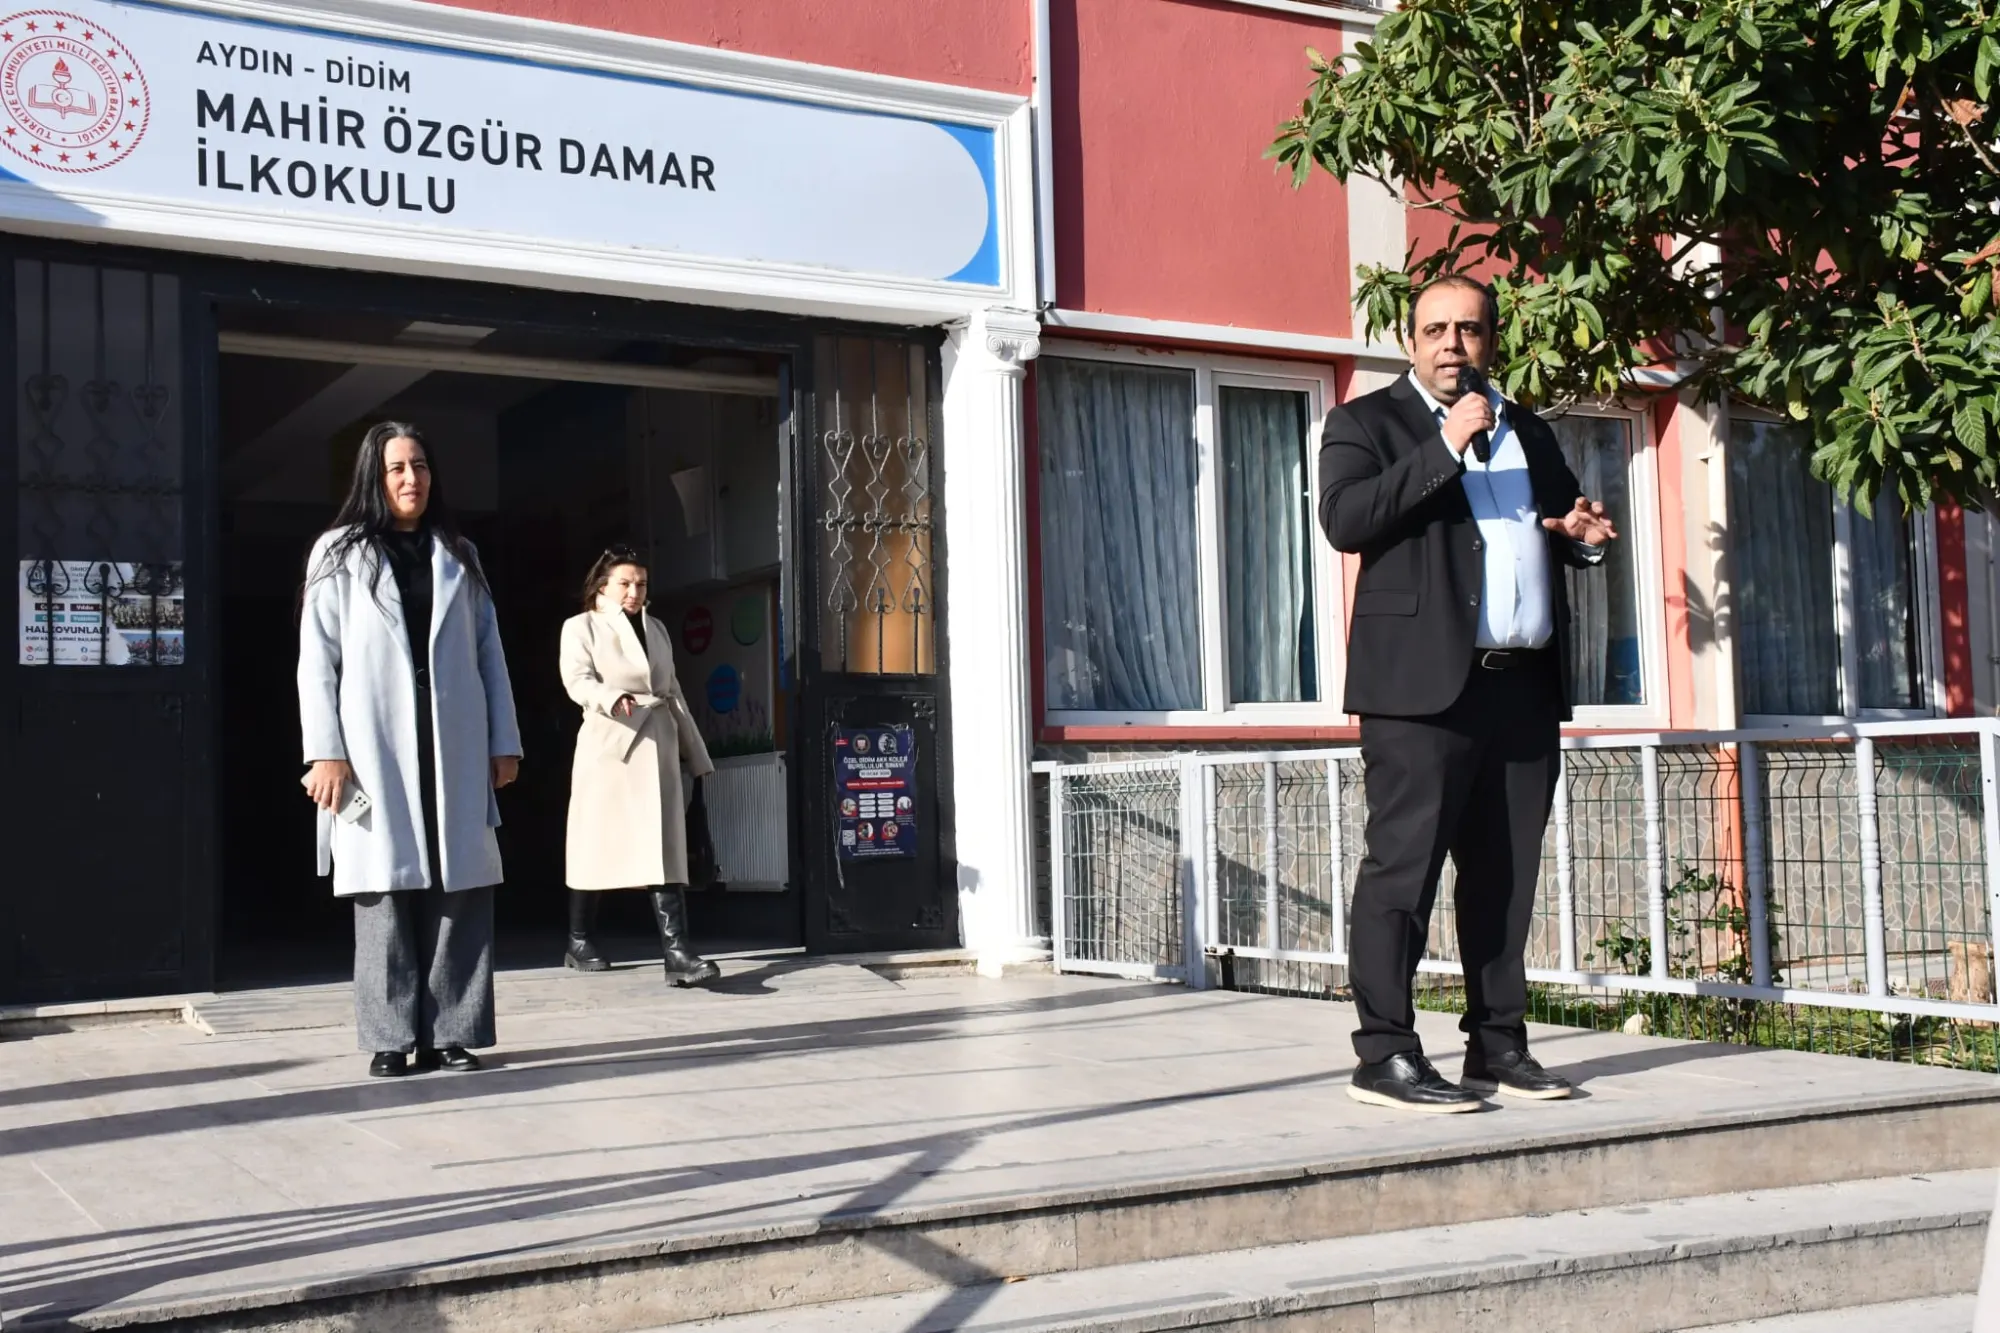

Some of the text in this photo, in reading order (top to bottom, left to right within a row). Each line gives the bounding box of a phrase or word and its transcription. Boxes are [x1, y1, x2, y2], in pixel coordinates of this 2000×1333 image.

[196, 40, 293, 77] AYDIN
[326, 57, 410, 94] DİDİM
[196, 89, 716, 192] MAHİR ÖZGÜR DAMAR
[197, 137, 456, 214] İLKOKULU
